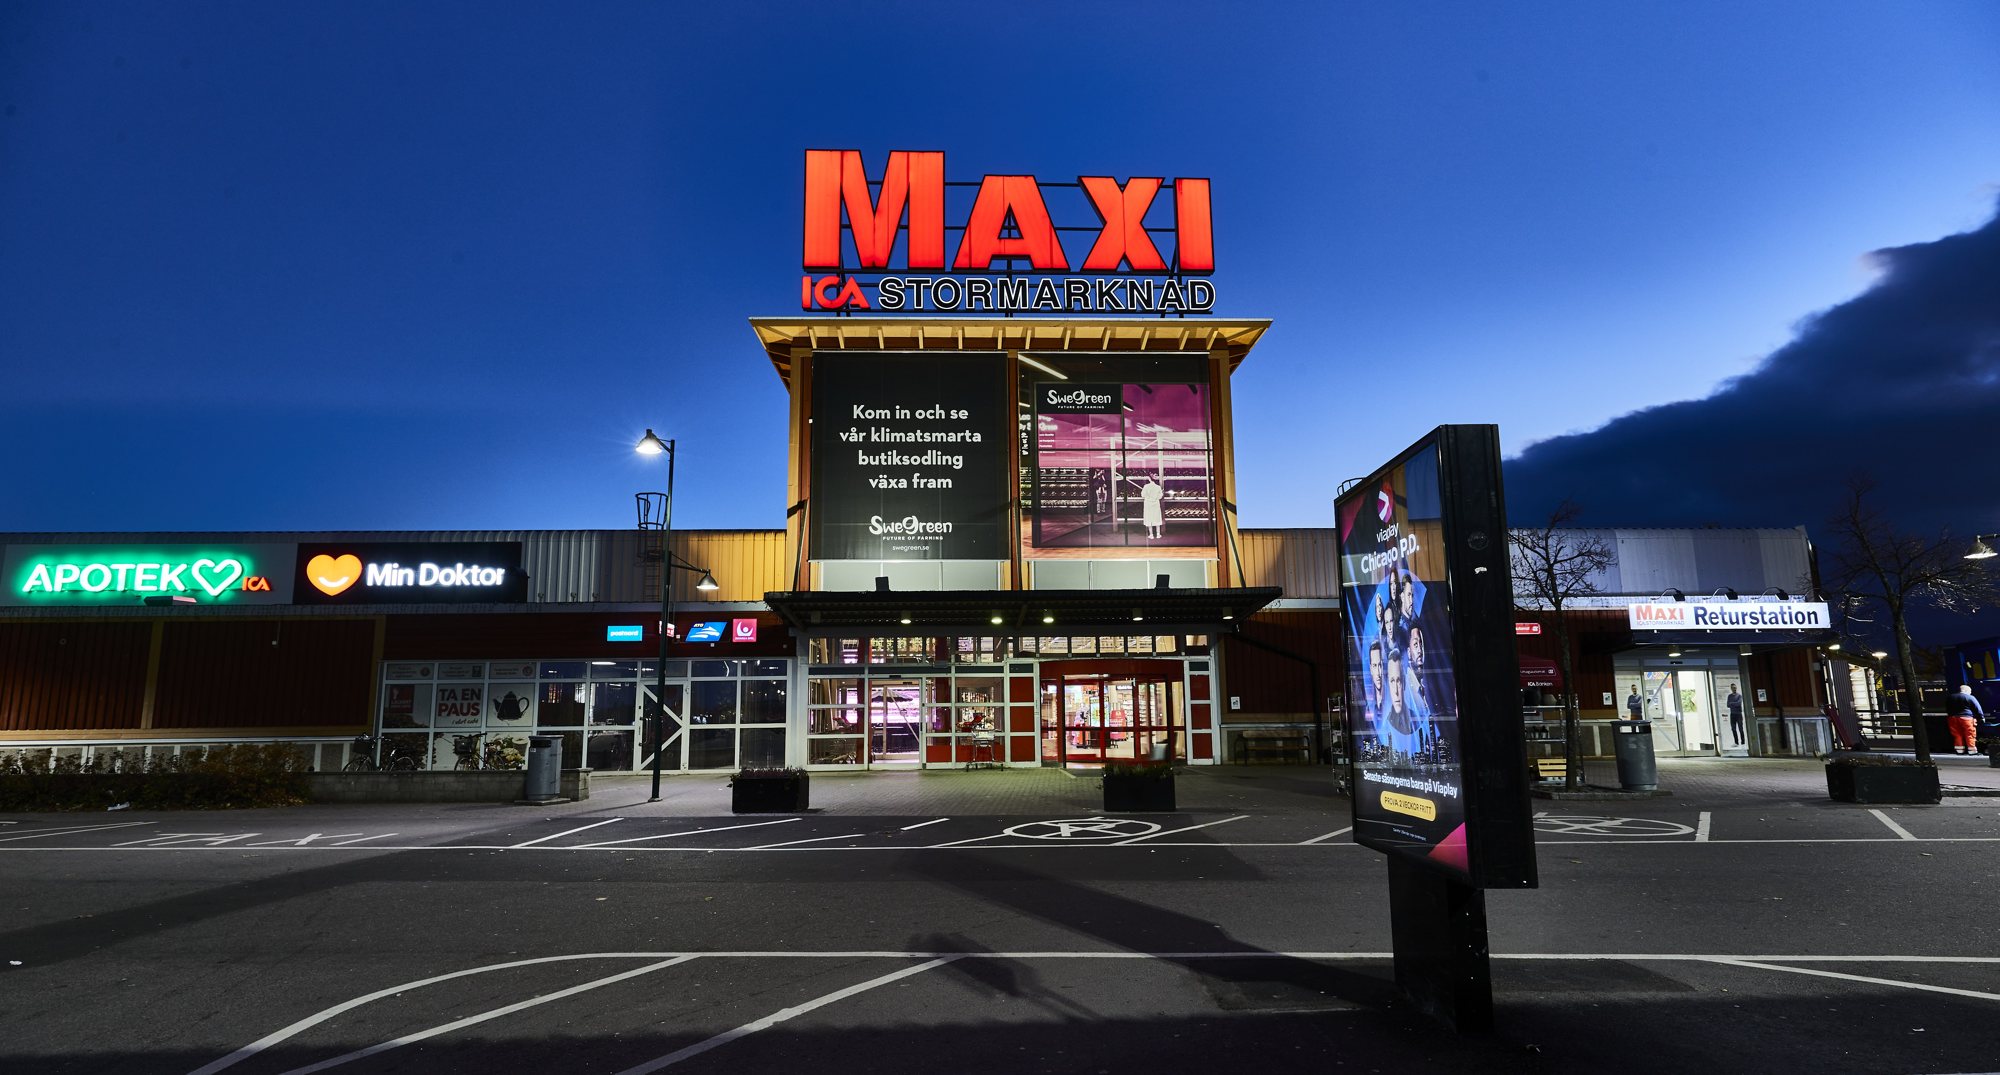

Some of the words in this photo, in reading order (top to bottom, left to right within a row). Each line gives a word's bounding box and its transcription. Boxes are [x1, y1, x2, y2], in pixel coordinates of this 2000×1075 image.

[803, 149, 1215, 274] MAXI
[801, 275, 871, 310] ICA
[878, 277, 1217, 312] STORMARKNAD
[853, 404, 890, 419] Kom
[895, 405, 911, 419] in
[915, 404, 945, 419] och
[950, 409, 969, 419] se
[839, 427, 866, 442] vår
[870, 427, 982, 442] klimatsmarta
[858, 450, 964, 469] butiksodling
[868, 474, 907, 489] växa
[912, 473, 953, 489] fram
[1361, 546, 1398, 573] Chicago
[1400, 533, 1420, 558] P.D.
[22, 563, 188, 593] APOTEK
[242, 576, 270, 592] ICA
[366, 562, 414, 587] Min
[419, 562, 505, 587] Doktor
[1635, 605, 1684, 620] MAXI
[1693, 605, 1819, 626] Returstation
[439, 688, 456, 701] TA
[461, 687, 482, 700] EN
[437, 702, 481, 717] PAUS
[1410, 777, 1424, 790] bara
[1424, 779, 1432, 793] på
[1432, 780, 1458, 798] Viaplay
